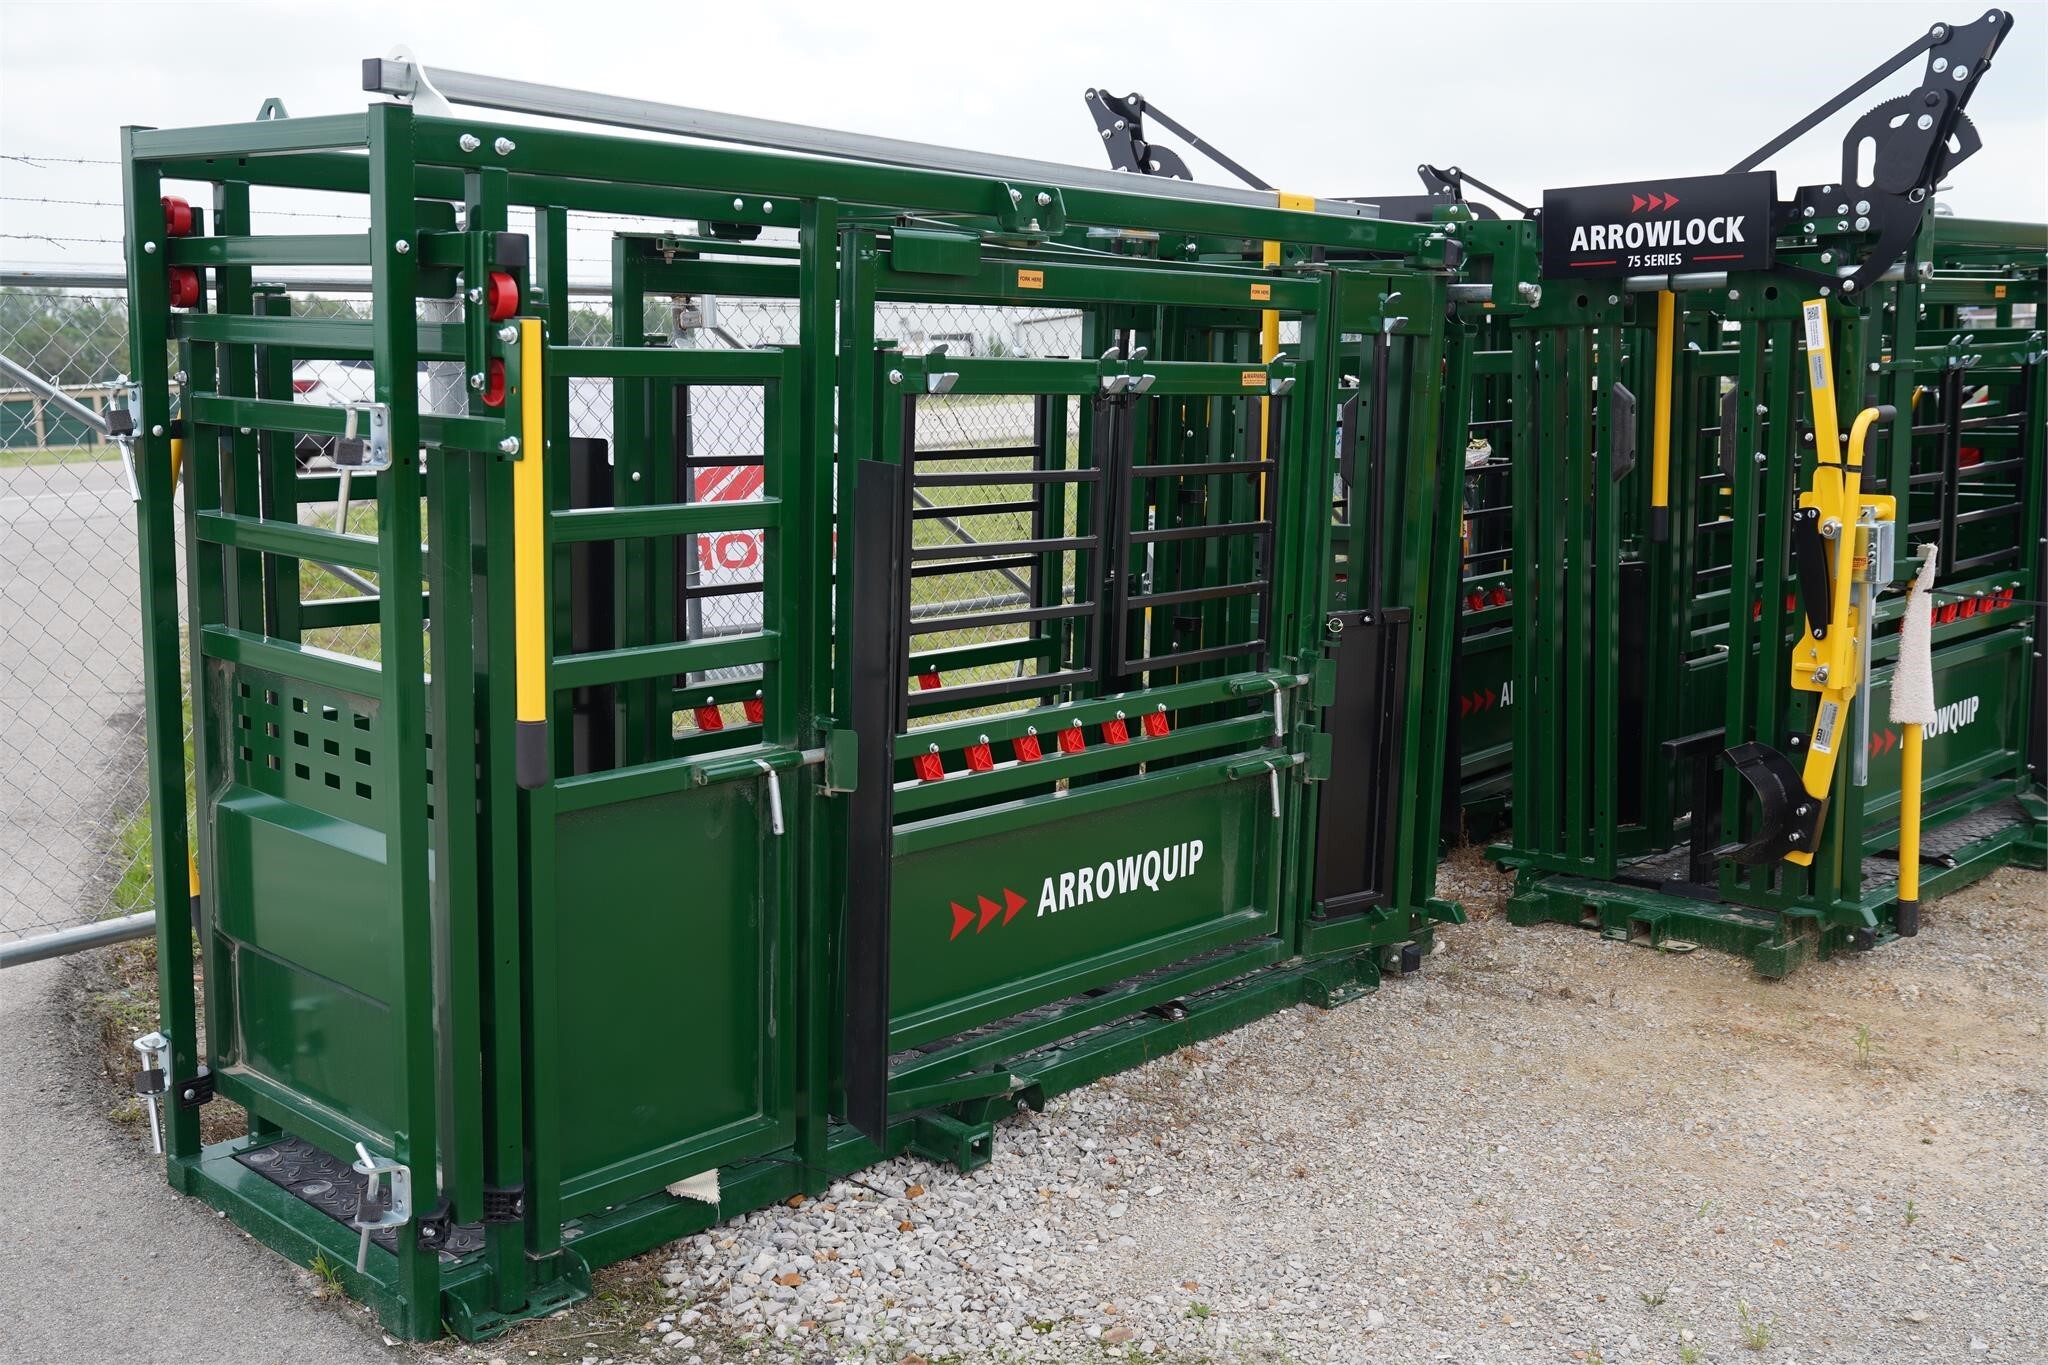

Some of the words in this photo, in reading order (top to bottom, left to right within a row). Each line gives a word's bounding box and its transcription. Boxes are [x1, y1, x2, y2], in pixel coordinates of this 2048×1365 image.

[1570, 215, 1745, 252] ARROWLOCK
[1627, 254, 1642, 268] 75
[1644, 253, 1682, 267] SERIES
[1899, 695, 1979, 750] OWQUIP
[1036, 838, 1204, 917] ARROWQUIP
